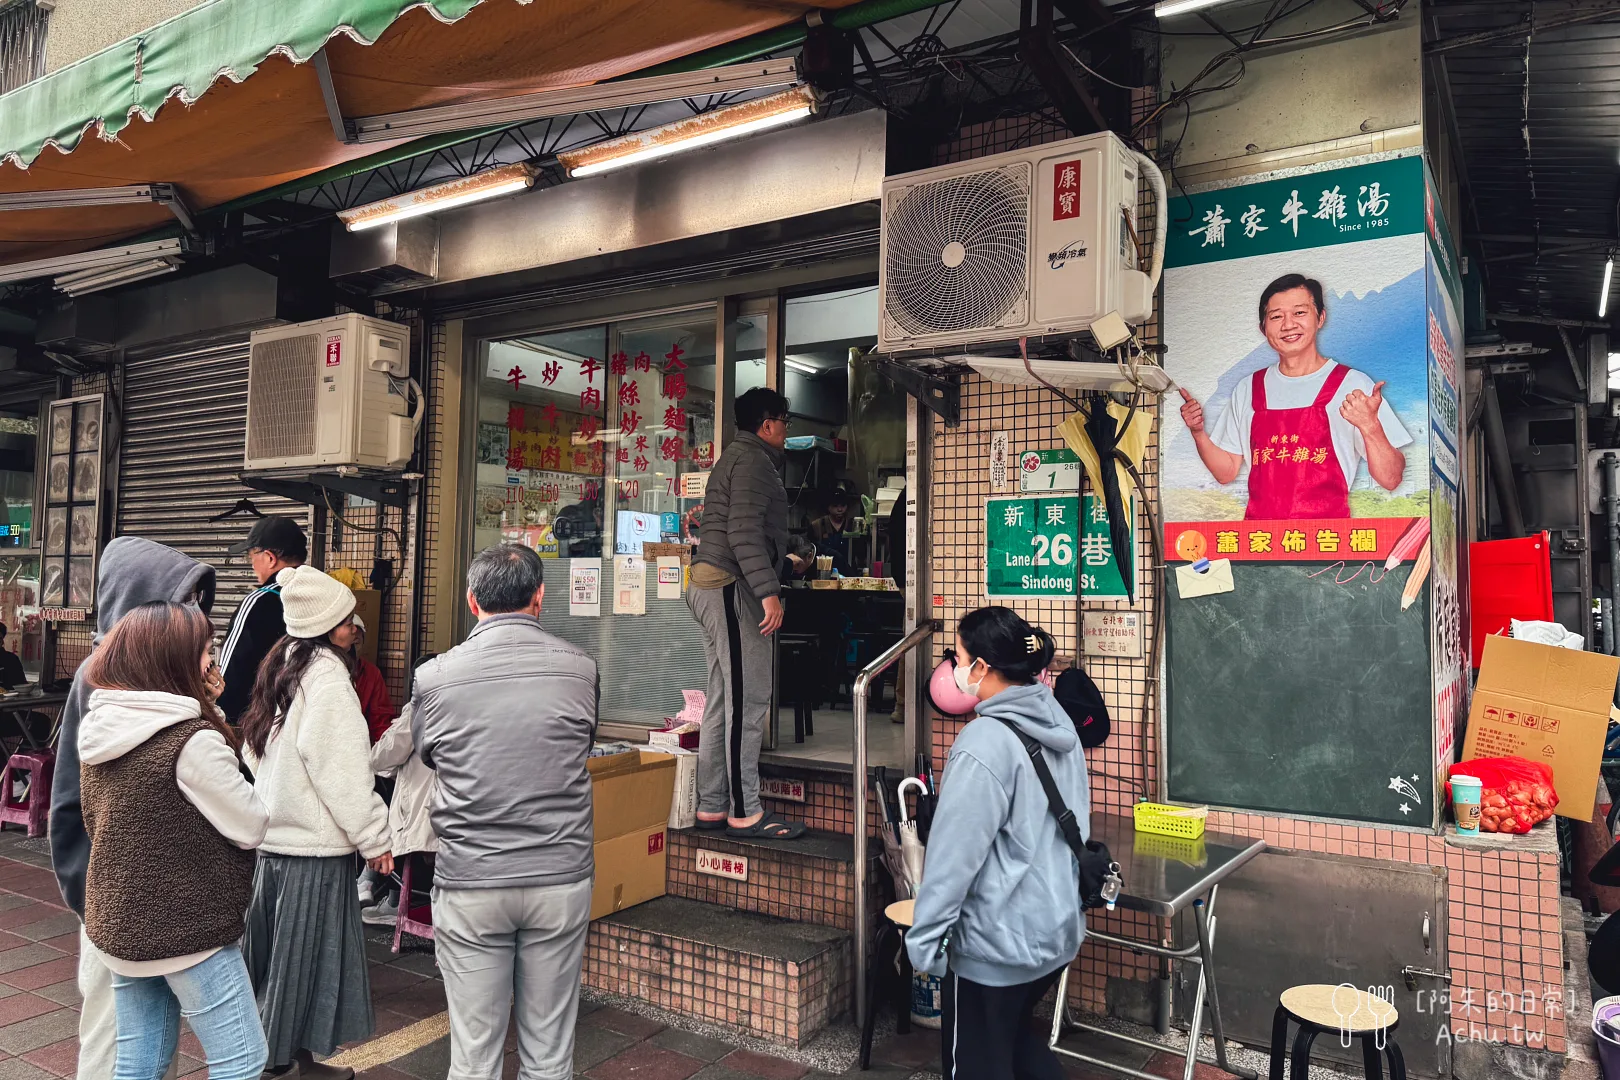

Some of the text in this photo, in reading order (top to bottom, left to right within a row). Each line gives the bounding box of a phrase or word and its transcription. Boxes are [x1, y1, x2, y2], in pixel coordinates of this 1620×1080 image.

[1058, 166, 1077, 214] 康寶
[1188, 182, 1390, 247] 蕭家牛雜湯
[1339, 218, 1389, 233] Since 1985
[1047, 247, 1087, 262] 變頻冷氣
[541, 360, 563, 469] 炒牛肉
[1271, 433, 1299, 444] 新東街
[666, 478, 681, 497] 70
[1048, 471, 1057, 488] 1
[506, 486, 524, 504] 110
[541, 484, 559, 502] 150
[579, 482, 599, 500] 130
[620, 480, 639, 499] 120
[1006, 552, 1030, 567] Lane
[1031, 533, 1072, 566] 26
[1216, 529, 1378, 553] 蕭家佈告欄
[1022, 574, 1099, 592] Sindong St.
[1102, 615, 1124, 625] 台北市
[760, 779, 802, 797] 小心階梯
[699, 852, 744, 875] 小心階梯
